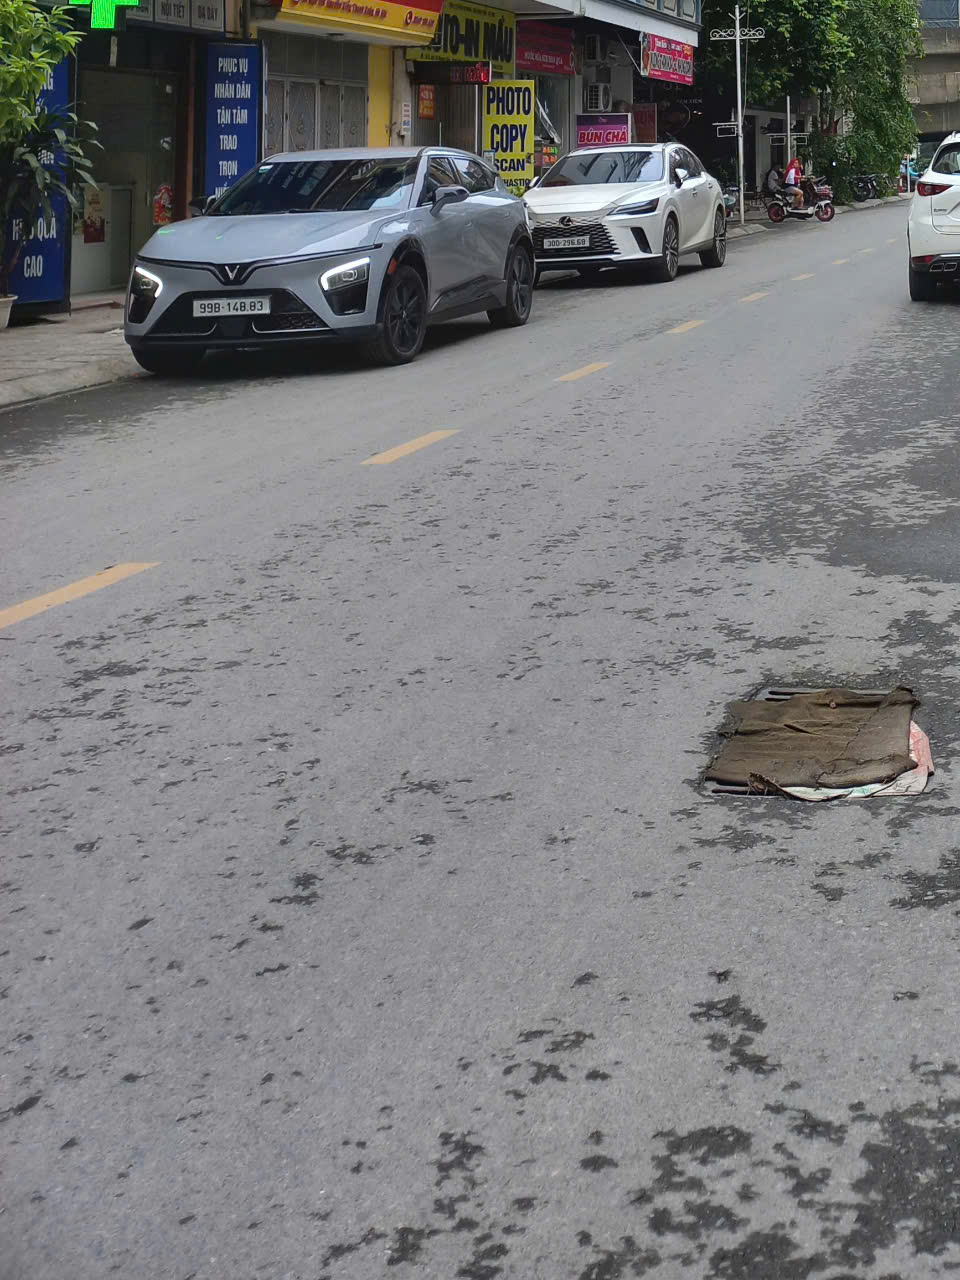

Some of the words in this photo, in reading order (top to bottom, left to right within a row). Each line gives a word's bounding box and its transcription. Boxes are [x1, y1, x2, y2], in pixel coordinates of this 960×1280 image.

[218, 58, 237, 76] PHỤC
[238, 58, 249, 76] VỤ
[214, 80, 235, 99] NHÂN
[236, 80, 251, 99] DÂN
[486, 86, 531, 116] PHOTO
[217, 106, 231, 128] TẬN
[232, 106, 248, 125] TÂM
[219, 135, 237, 150] TRAO
[490, 123, 527, 153] COPY
[578, 128, 602, 144] BÚN
[605, 125, 628, 144] CHẢ
[219, 160, 238, 180] TRỌN
[495, 158, 525, 172] SCAN
[23, 255, 43, 278] CAO
[199, 300, 264, 314] 99B-148.83
